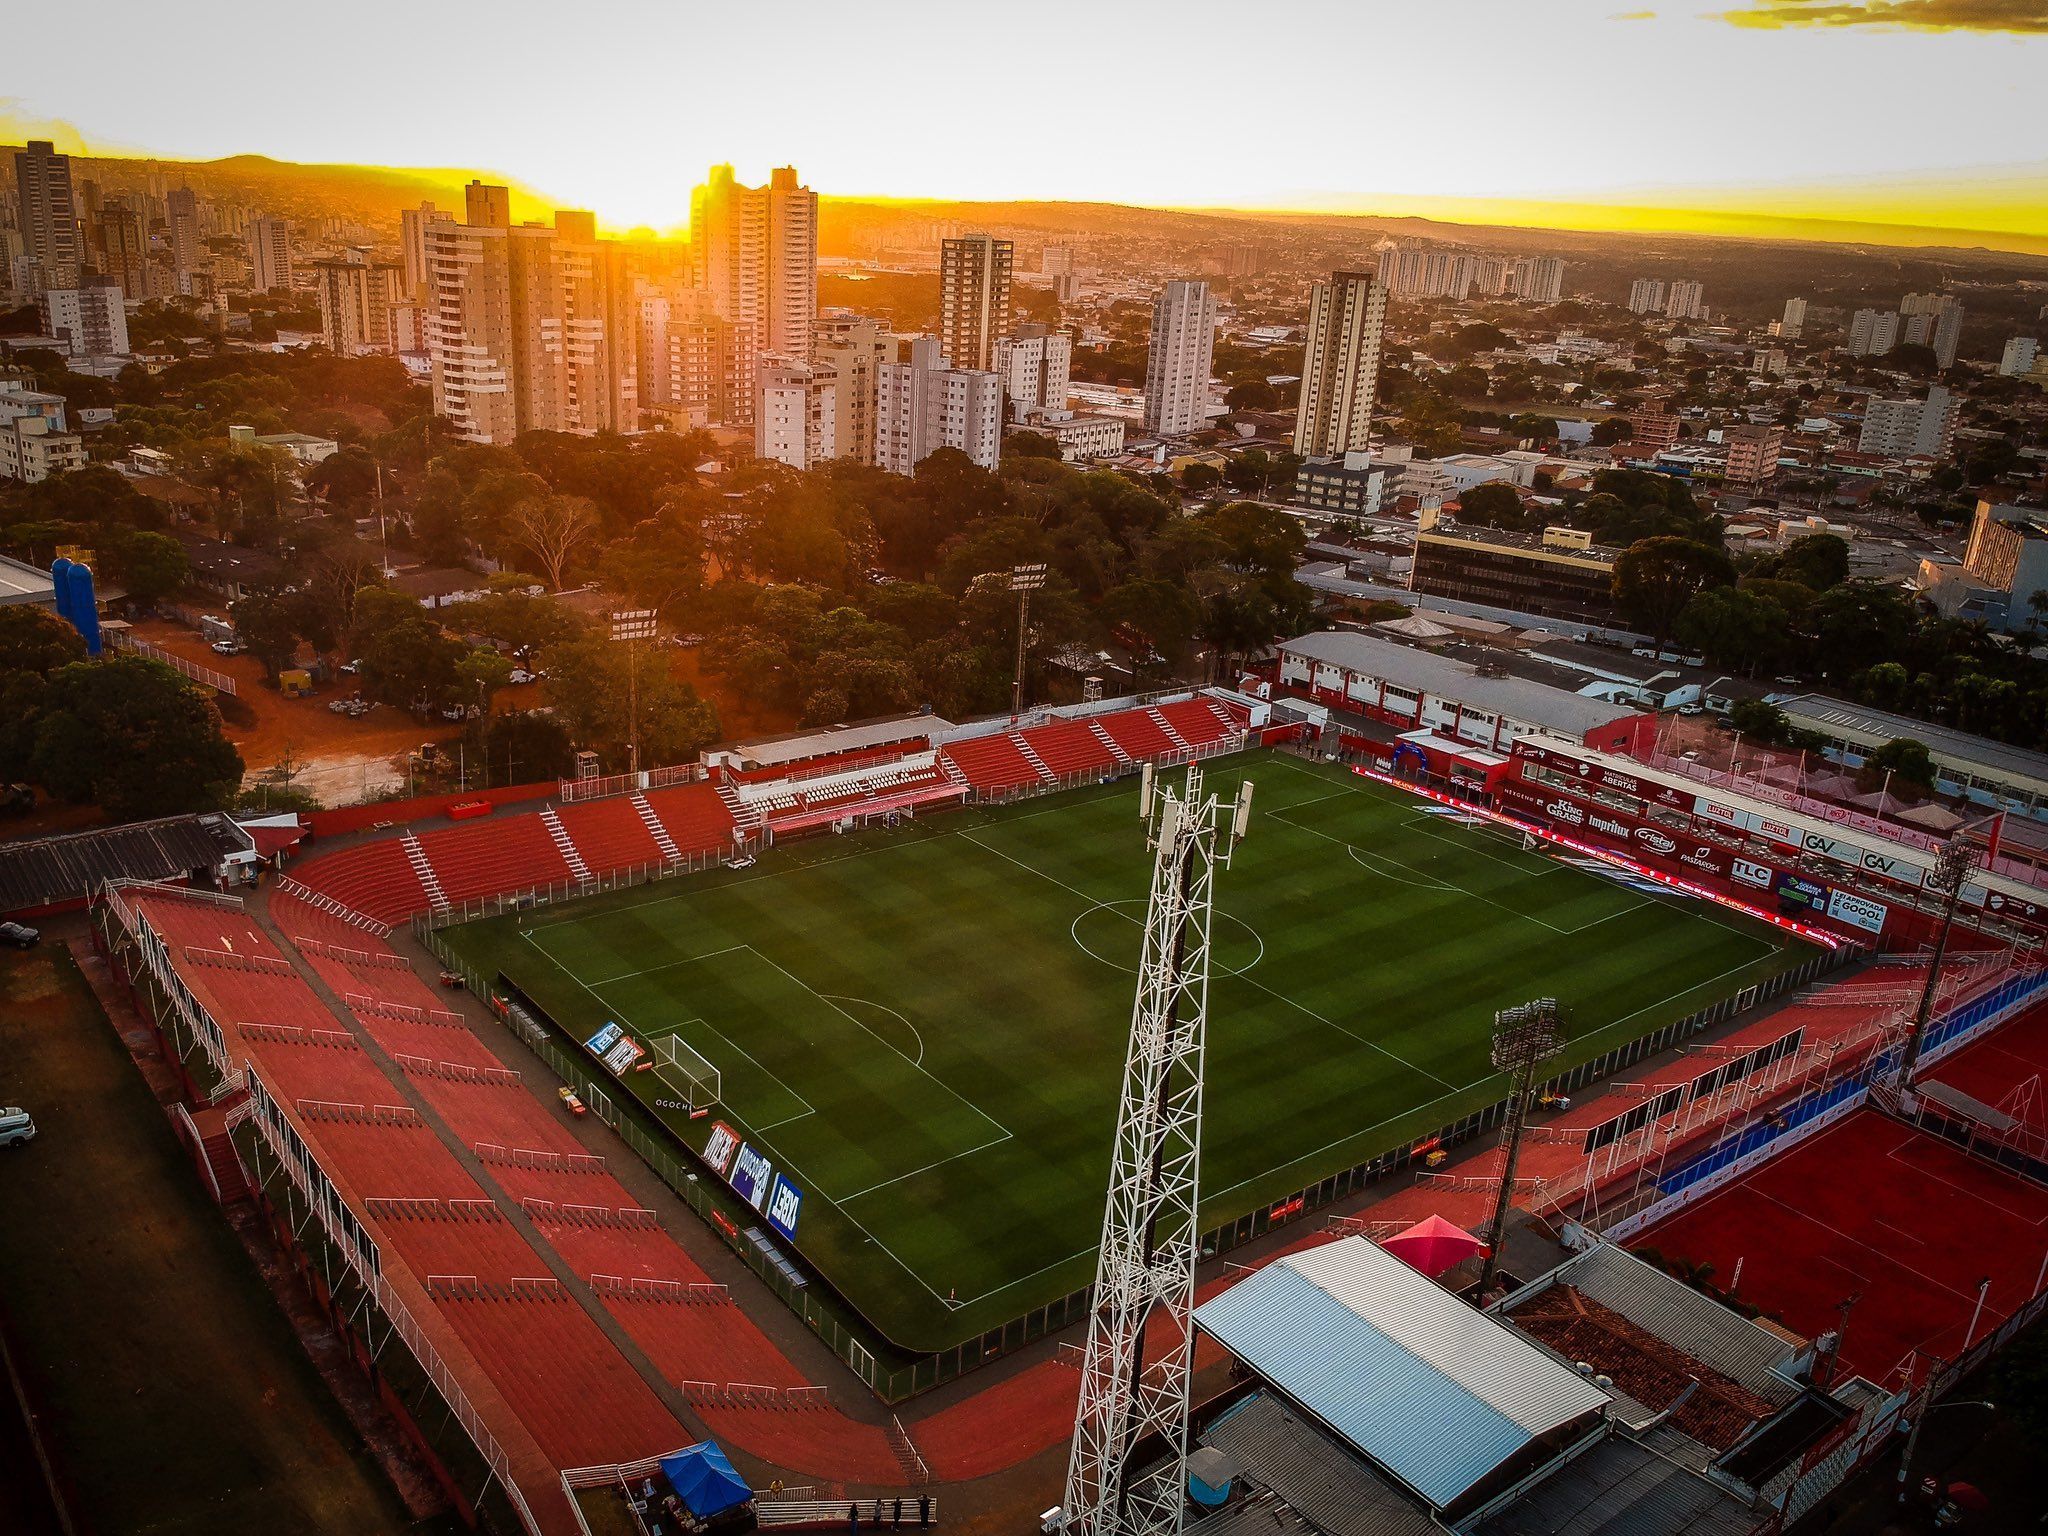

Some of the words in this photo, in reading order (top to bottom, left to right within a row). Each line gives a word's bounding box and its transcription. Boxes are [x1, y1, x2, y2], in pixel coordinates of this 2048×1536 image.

[1602, 775, 1637, 792] ABERTAS
[1708, 805, 1733, 819] LUZTOL
[1762, 821, 1788, 837] LUZTOL
[1637, 831, 1675, 848] Cristal
[1805, 835, 1836, 854] GAV
[1680, 854, 1720, 873] PASTAROSA
[1734, 861, 1769, 881] TLC
[1864, 854, 1896, 873] GAV
[1833, 897, 1841, 907] É
[1842, 903, 1881, 922] GOOOL
[1835, 892, 1847, 900] LEI
[1847, 895, 1884, 913] APROVADA
